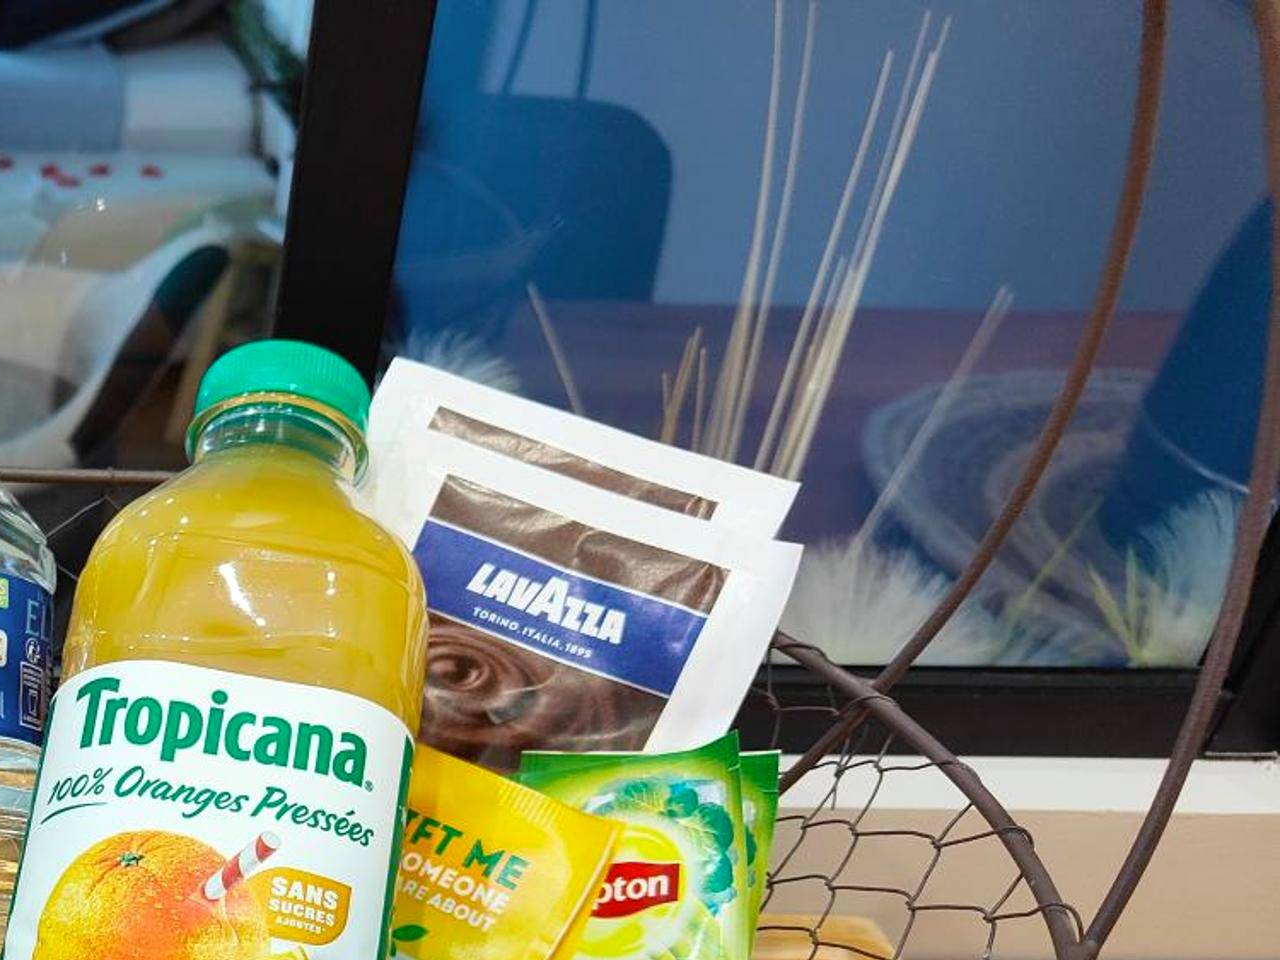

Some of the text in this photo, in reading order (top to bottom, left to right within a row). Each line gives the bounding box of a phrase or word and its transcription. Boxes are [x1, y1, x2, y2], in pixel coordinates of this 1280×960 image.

[465, 562, 627, 645] LAVAZZA
[76, 677, 368, 788] Tropicana
[47, 766, 375, 848] 100% Oranges Pressées
[462, 838, 530, 890] ME
[268, 898, 335, 928] SUCRES
[271, 876, 339, 911] SANS
[427, 892, 496, 933] ABOUT
[591, 874, 669, 911] pton
